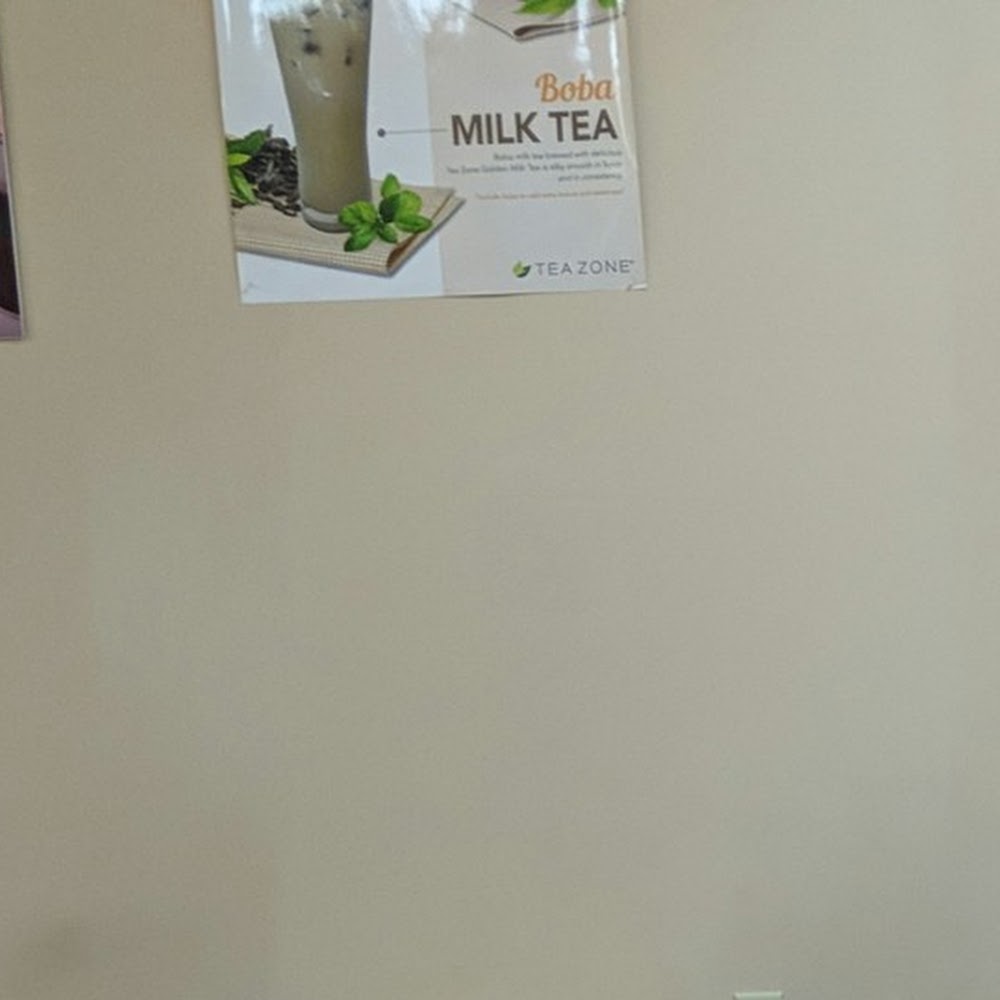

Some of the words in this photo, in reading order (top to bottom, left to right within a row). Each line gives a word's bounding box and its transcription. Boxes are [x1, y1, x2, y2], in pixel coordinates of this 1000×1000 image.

[535, 72, 615, 103] Boba
[451, 111, 541, 146] MILK
[548, 108, 618, 142] TEA
[535, 262, 572, 276] TEA
